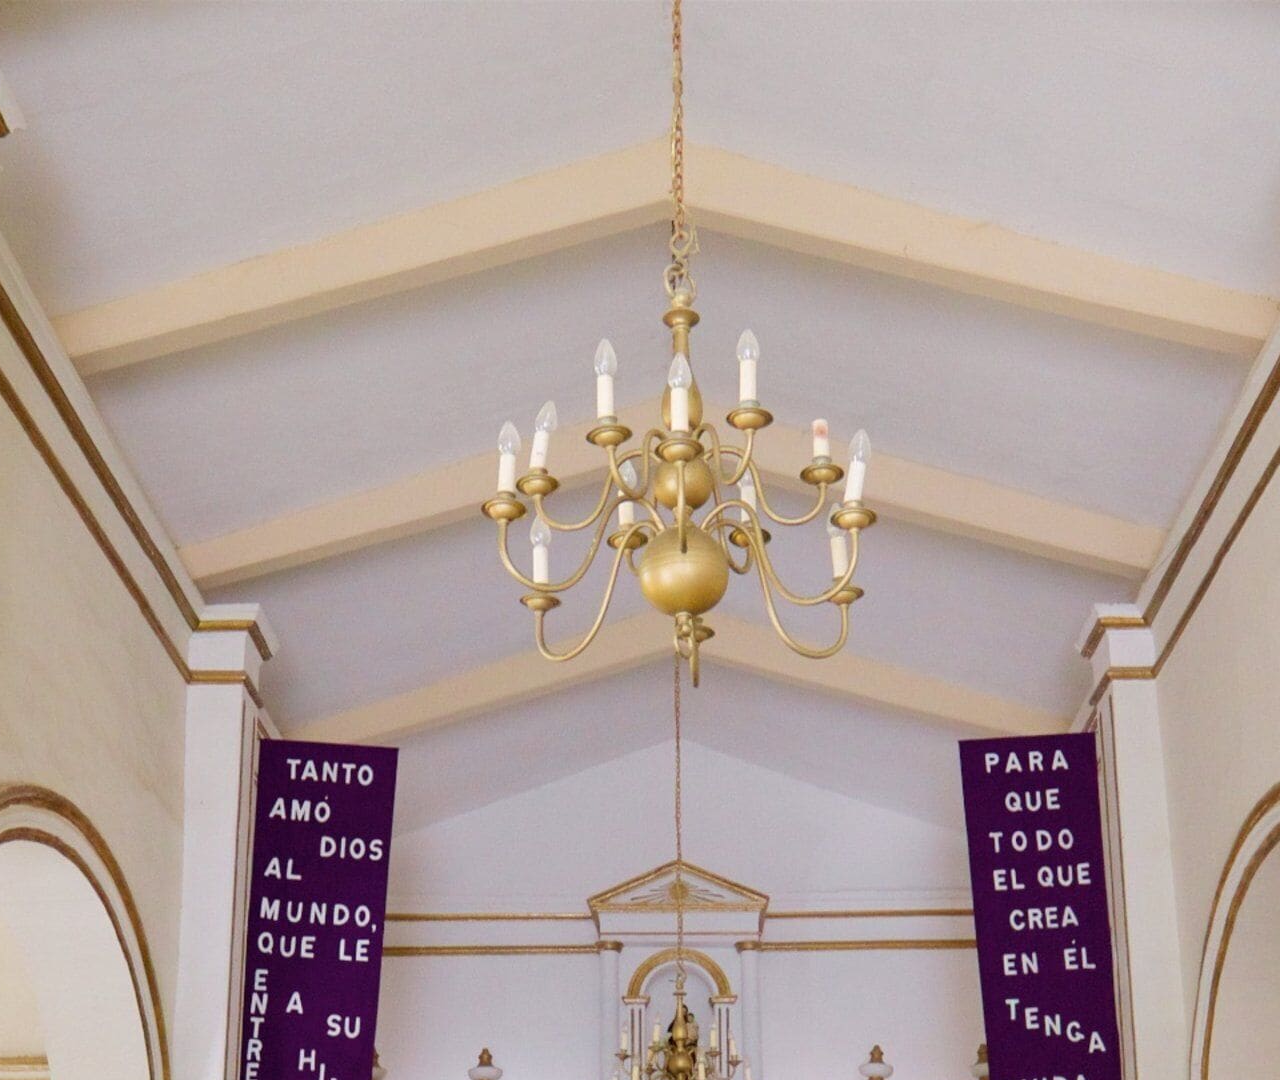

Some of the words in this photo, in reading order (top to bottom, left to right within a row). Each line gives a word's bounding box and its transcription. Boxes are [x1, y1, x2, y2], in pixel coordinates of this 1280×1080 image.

[286, 758, 374, 787] TANTO
[985, 750, 1069, 774] PARA
[1004, 788, 1061, 813] QUE
[319, 835, 384, 862] DIOS
[988, 829, 1075, 854] TODO
[263, 856, 303, 881] AL
[992, 868, 1026, 892] EL
[1036, 862, 1092, 888] QUE
[259, 896, 378, 932] MUNDO,
[1008, 905, 1080, 932] CREA
[257, 931, 317, 959] QUE
[338, 937, 371, 963] LE
[1002, 951, 1039, 977] EN
[285, 990, 304, 1015] A
[326, 1013, 362, 1040] SU
[1004, 997, 1107, 1054] TENGA
